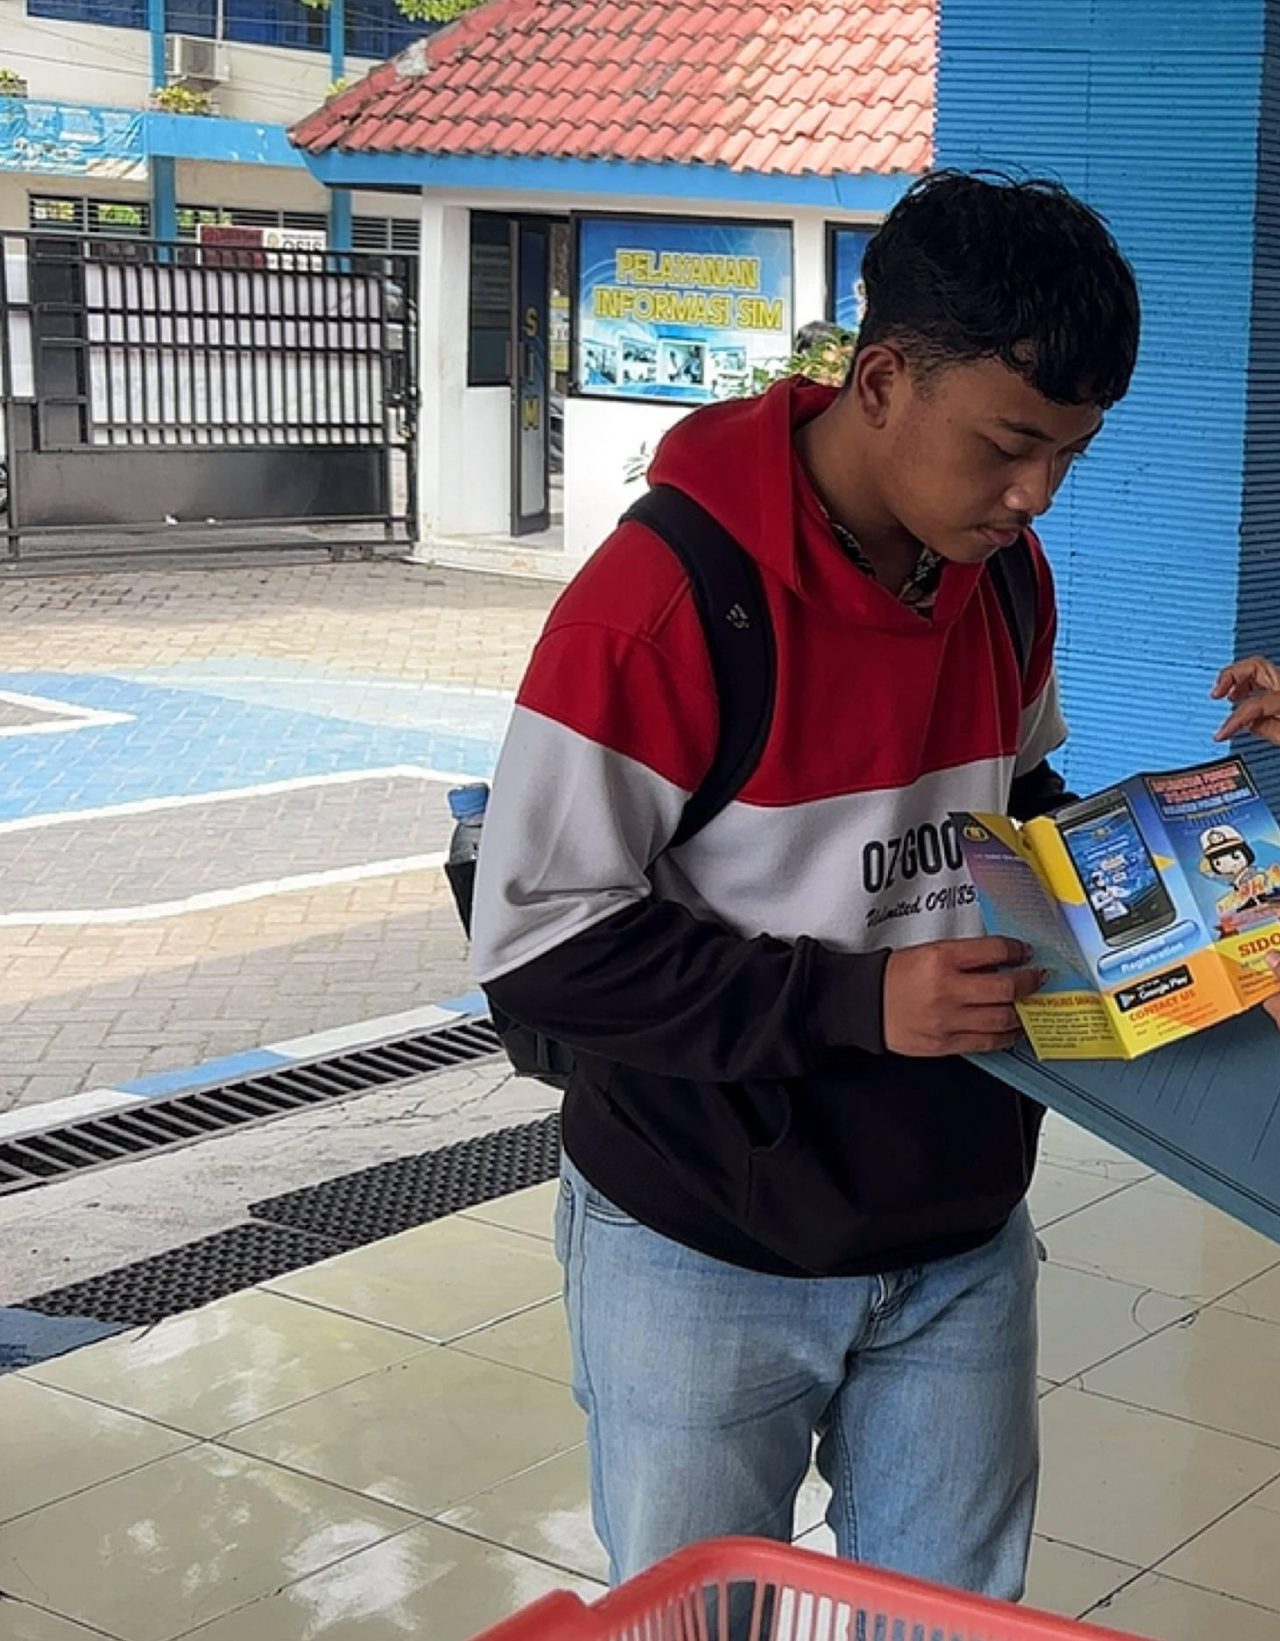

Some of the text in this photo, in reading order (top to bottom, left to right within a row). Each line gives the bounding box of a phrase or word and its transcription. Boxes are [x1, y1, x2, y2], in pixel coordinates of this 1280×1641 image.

[616, 249, 759, 290] PELAYANAN
[594, 287, 784, 331] INFORMASI SIM
